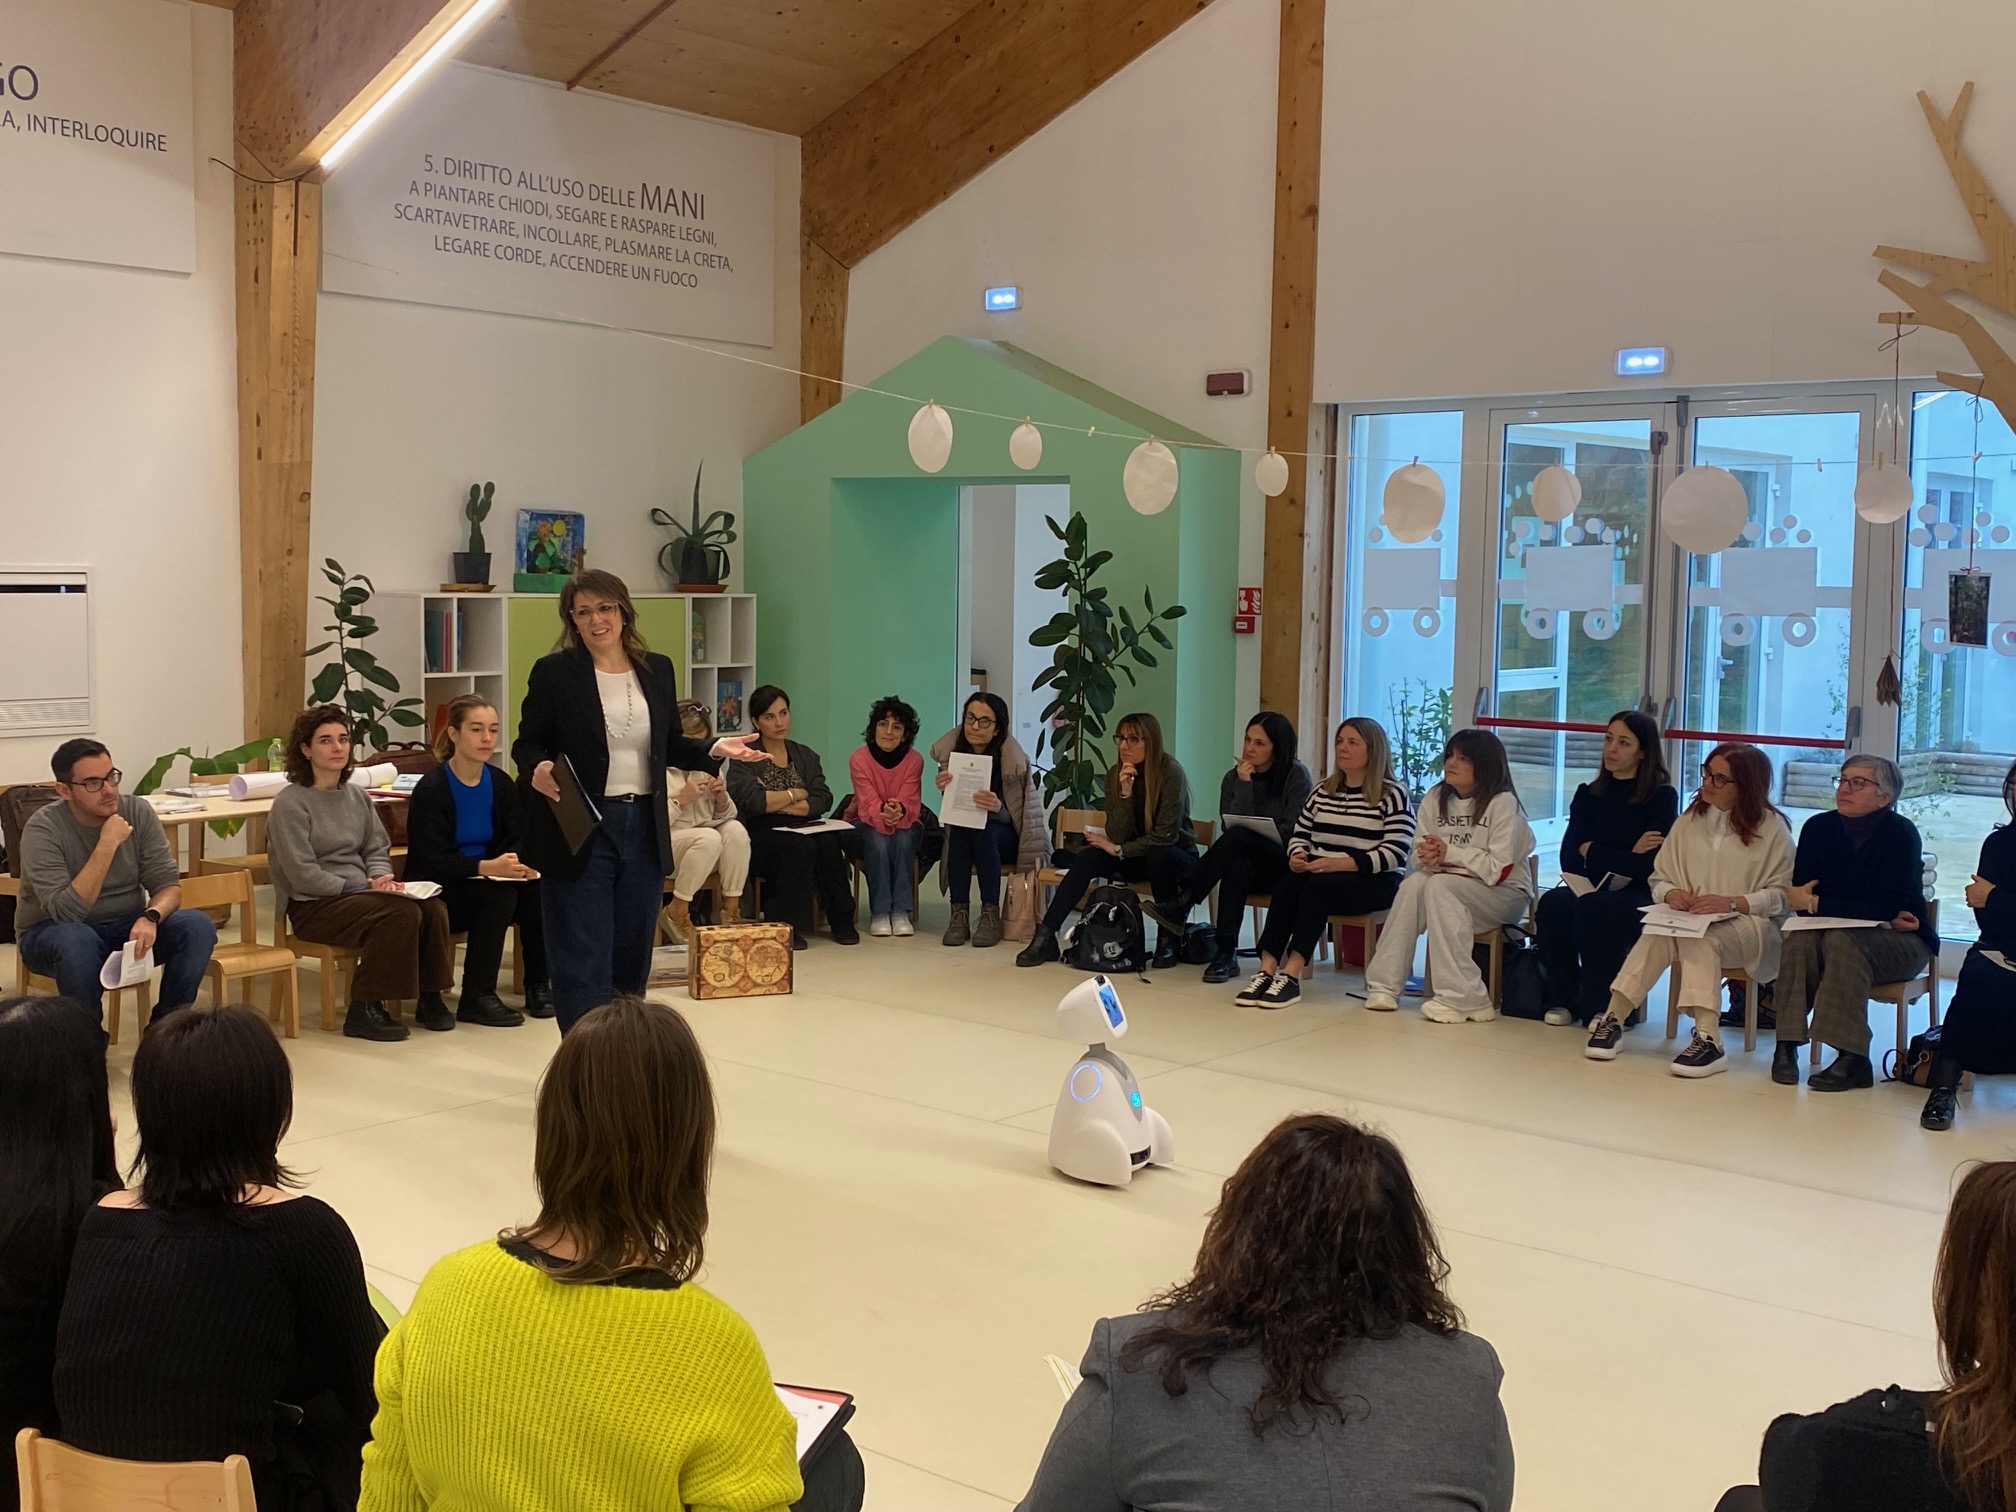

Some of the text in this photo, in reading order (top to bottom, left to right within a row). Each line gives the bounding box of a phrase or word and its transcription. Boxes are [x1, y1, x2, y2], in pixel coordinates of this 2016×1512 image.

[0, 62, 39, 101] O
[0, 110, 167, 152] A, INTERLOQUIRE
[409, 180, 718, 248] A PIANTARE CHIODI, SEGARE E RASPARE LEGNI,
[424, 154, 439, 174] 5.
[444, 157, 512, 186] DIRITTO
[589, 184, 636, 209] DELLE
[641, 182, 705, 221] MANI
[394, 203, 734, 273] SCARTAVETRARE, INCOLLARE, PLASMARE LA CRETA,
[434, 235, 698, 288] LEGARE CORDE, ACCENDERE UN FUOCO
